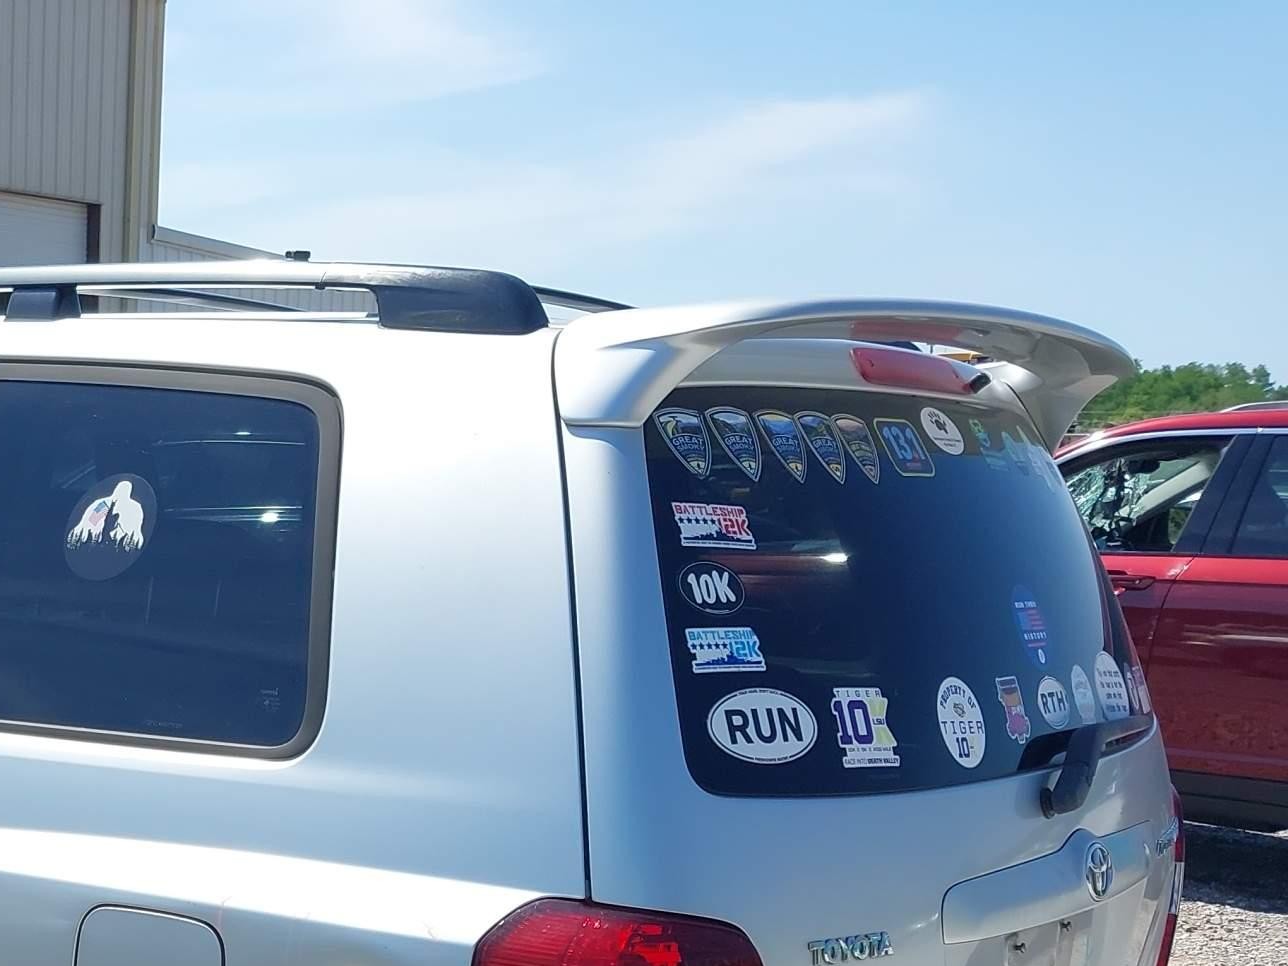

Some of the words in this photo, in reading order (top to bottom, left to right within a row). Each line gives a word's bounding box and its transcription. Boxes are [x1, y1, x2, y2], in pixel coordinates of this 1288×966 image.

[672, 435, 704, 446] GREAT
[724, 435, 753, 446] GREAT
[674, 504, 745, 518] BATTLESHIP
[687, 570, 737, 604] 10K
[688, 629, 755, 641] BATTLESHIP
[835, 690, 880, 698] TIGER
[939, 685, 966, 709] PROPERTY
[1040, 690, 1066, 715] RTH
[724, 707, 804, 744] RUN
[941, 720, 984, 735] TIGER
[808, 931, 894, 966] TOYOTA
